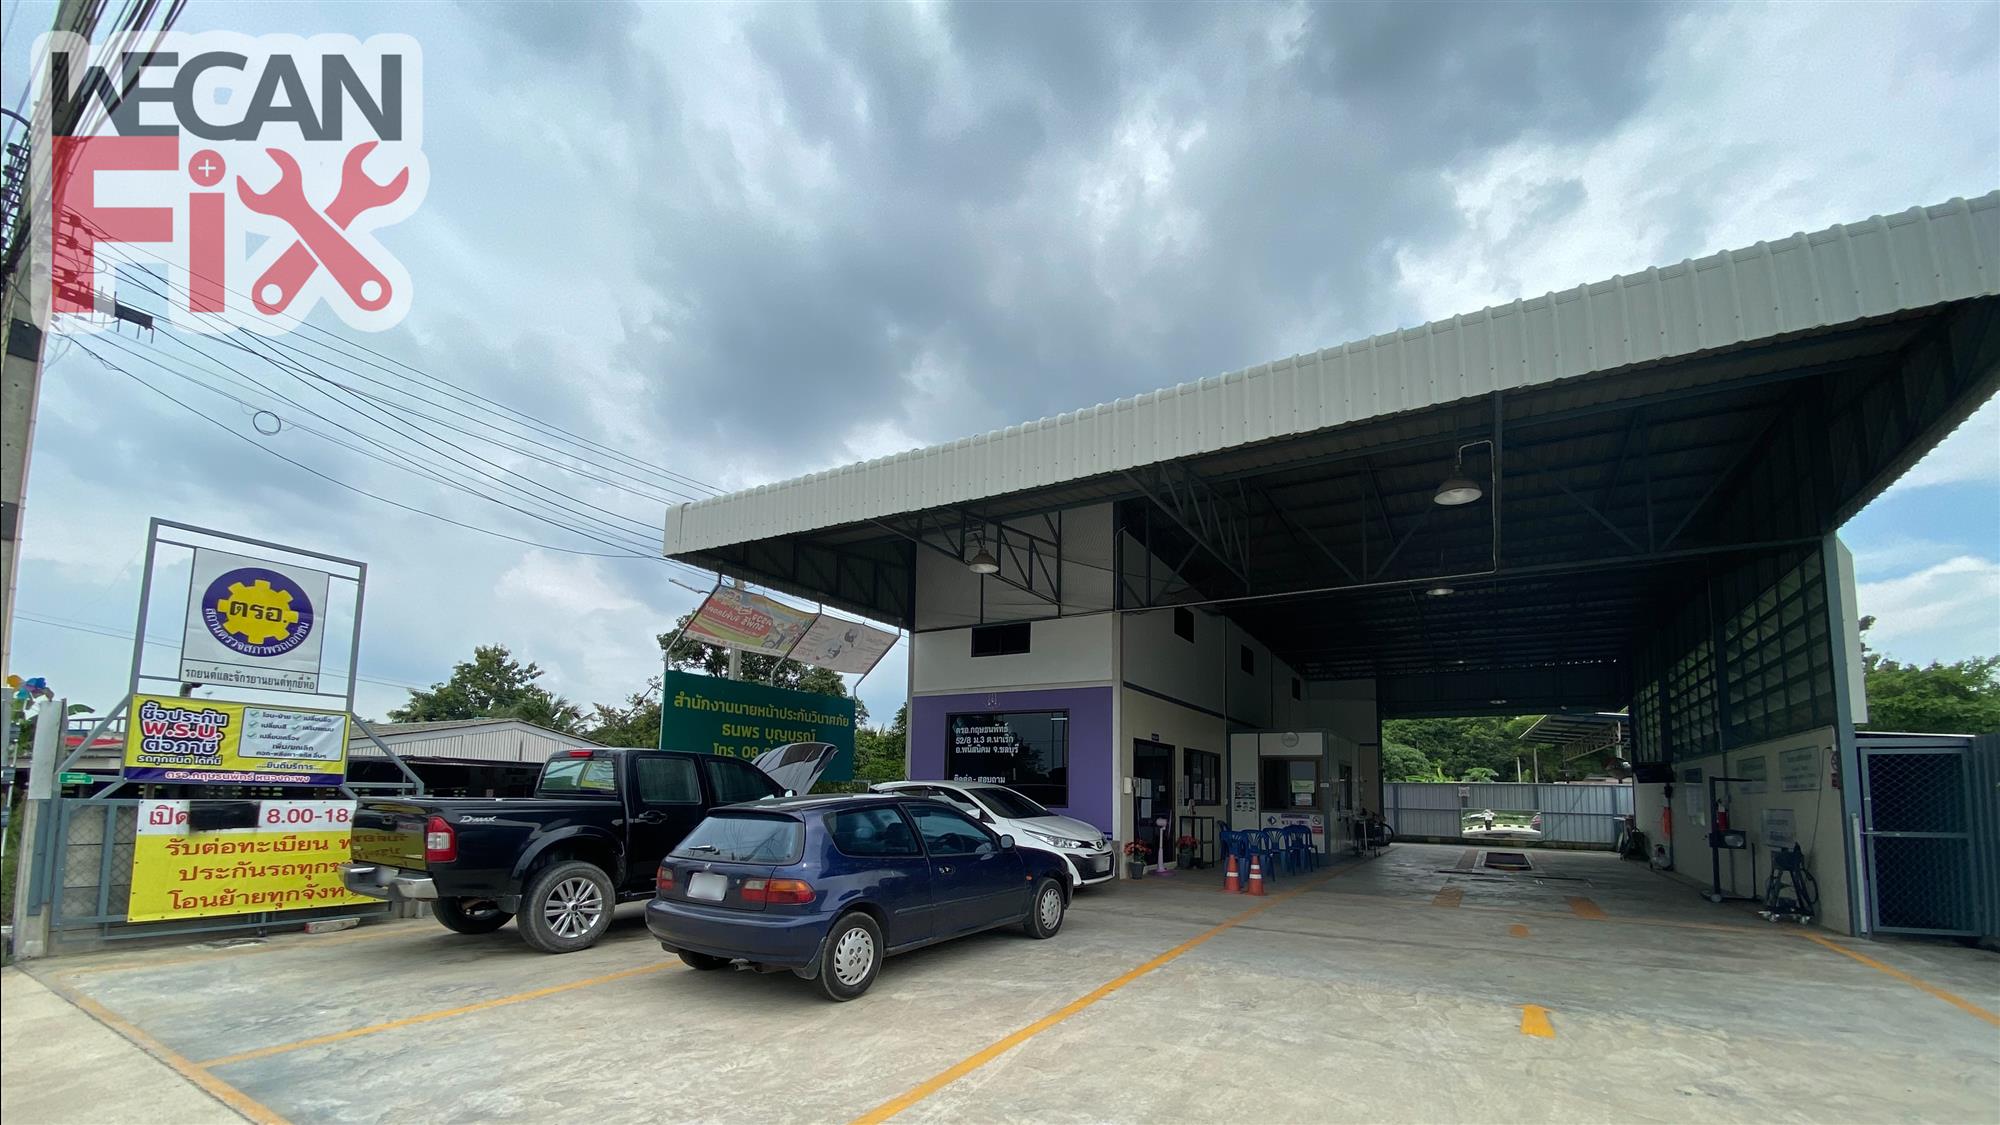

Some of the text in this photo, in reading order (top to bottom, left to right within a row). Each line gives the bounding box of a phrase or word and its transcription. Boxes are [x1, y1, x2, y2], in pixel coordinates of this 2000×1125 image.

[229, 601, 287, 623] ตรอ.
[205, 607, 310, 655] สถานตรวจสภาพรถเอกชน
[185, 667, 315, 690] รถยนต์และจักรยานยนต์ทุกยี่ห้อ
[142, 702, 227, 726] ซื้อประกัน
[673, 691, 849, 728] สำนักงานนายหน้าประกันวินาศภัย
[143, 720, 223, 739] พ.ร.บ.
[722, 723, 760, 739] ธนพร
[955, 736, 972, 745] 52/8
[144, 736, 218, 754] ต่อภาษี
[150, 804, 192, 825] เปิด
[165, 835, 329, 857] รับต่อทะเบียน
[168, 883, 346, 911] โอนย้ายทุกจังห
